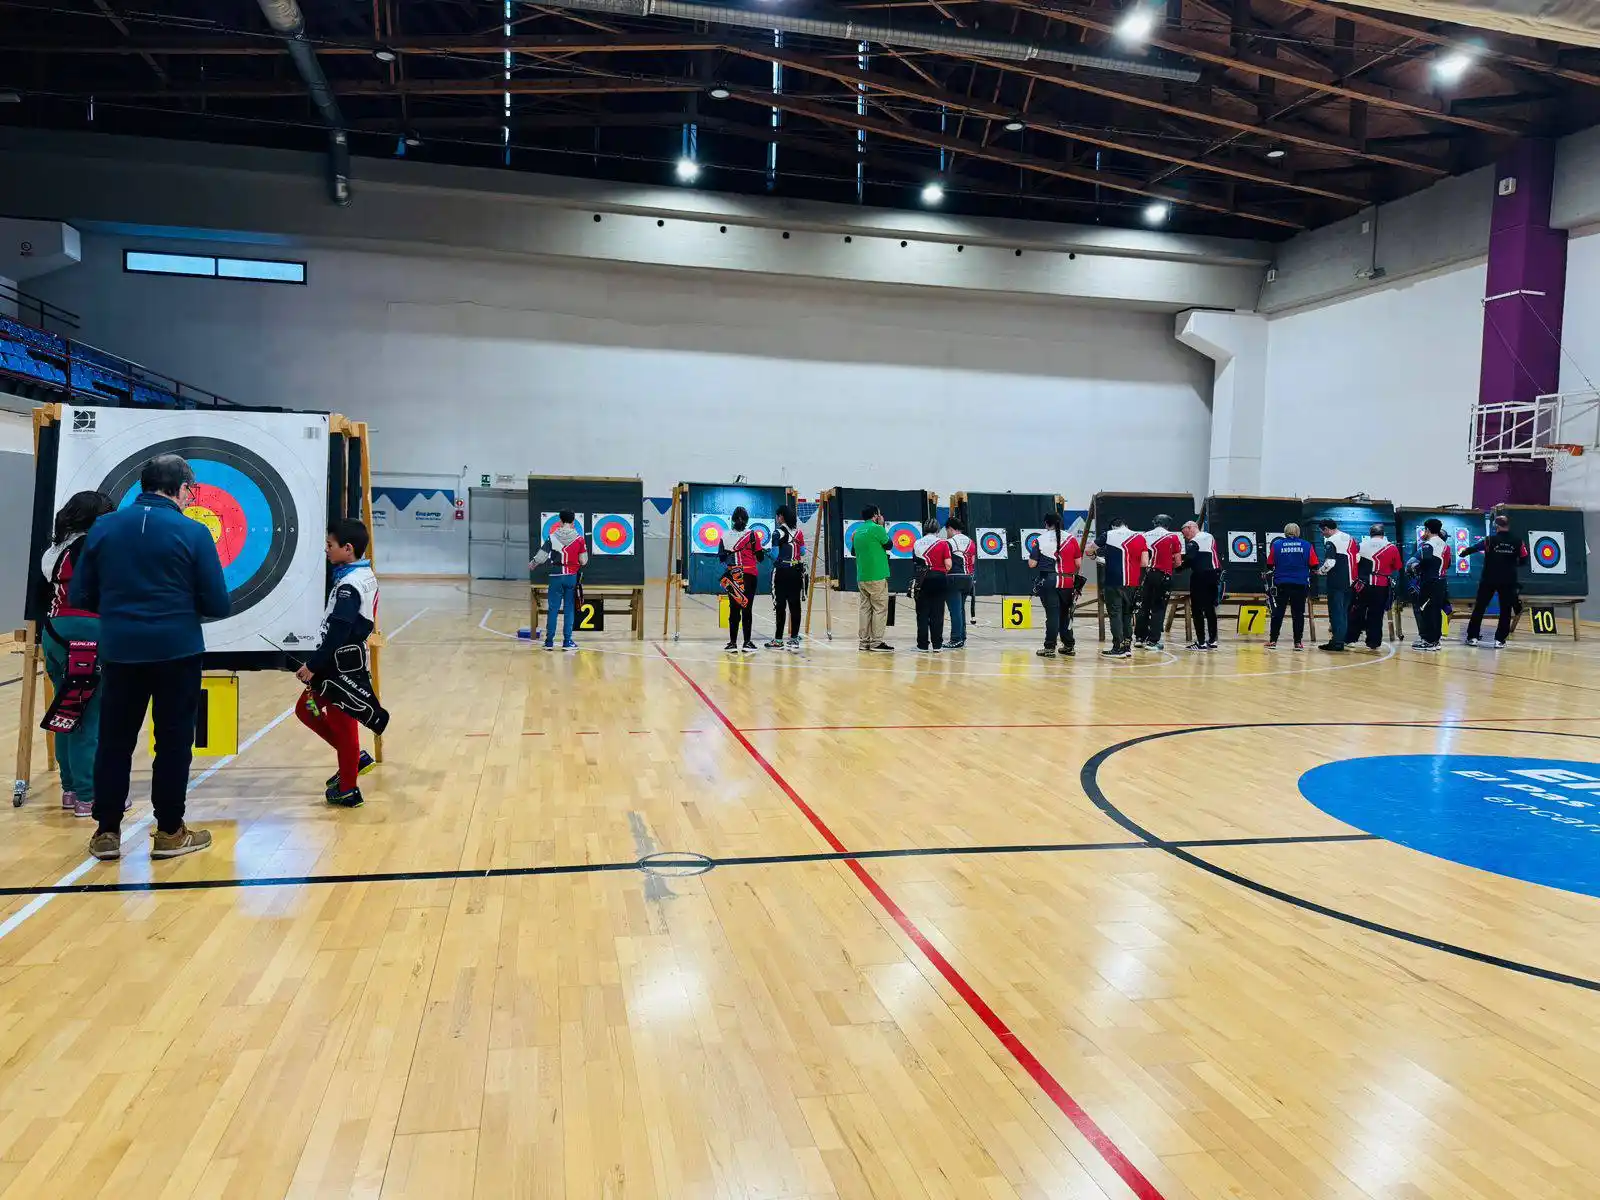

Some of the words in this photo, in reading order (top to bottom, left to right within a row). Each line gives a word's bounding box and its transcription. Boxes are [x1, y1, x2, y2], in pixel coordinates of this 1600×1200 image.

[580, 604, 594, 628] 2
[1011, 603, 1023, 625] 5
[1247, 610, 1258, 631] 7
[1534, 611, 1553, 631] 10
[339, 674, 371, 698] AVALON
[1450, 770, 1511, 781] El
[1498, 784, 1596, 808] Pas
